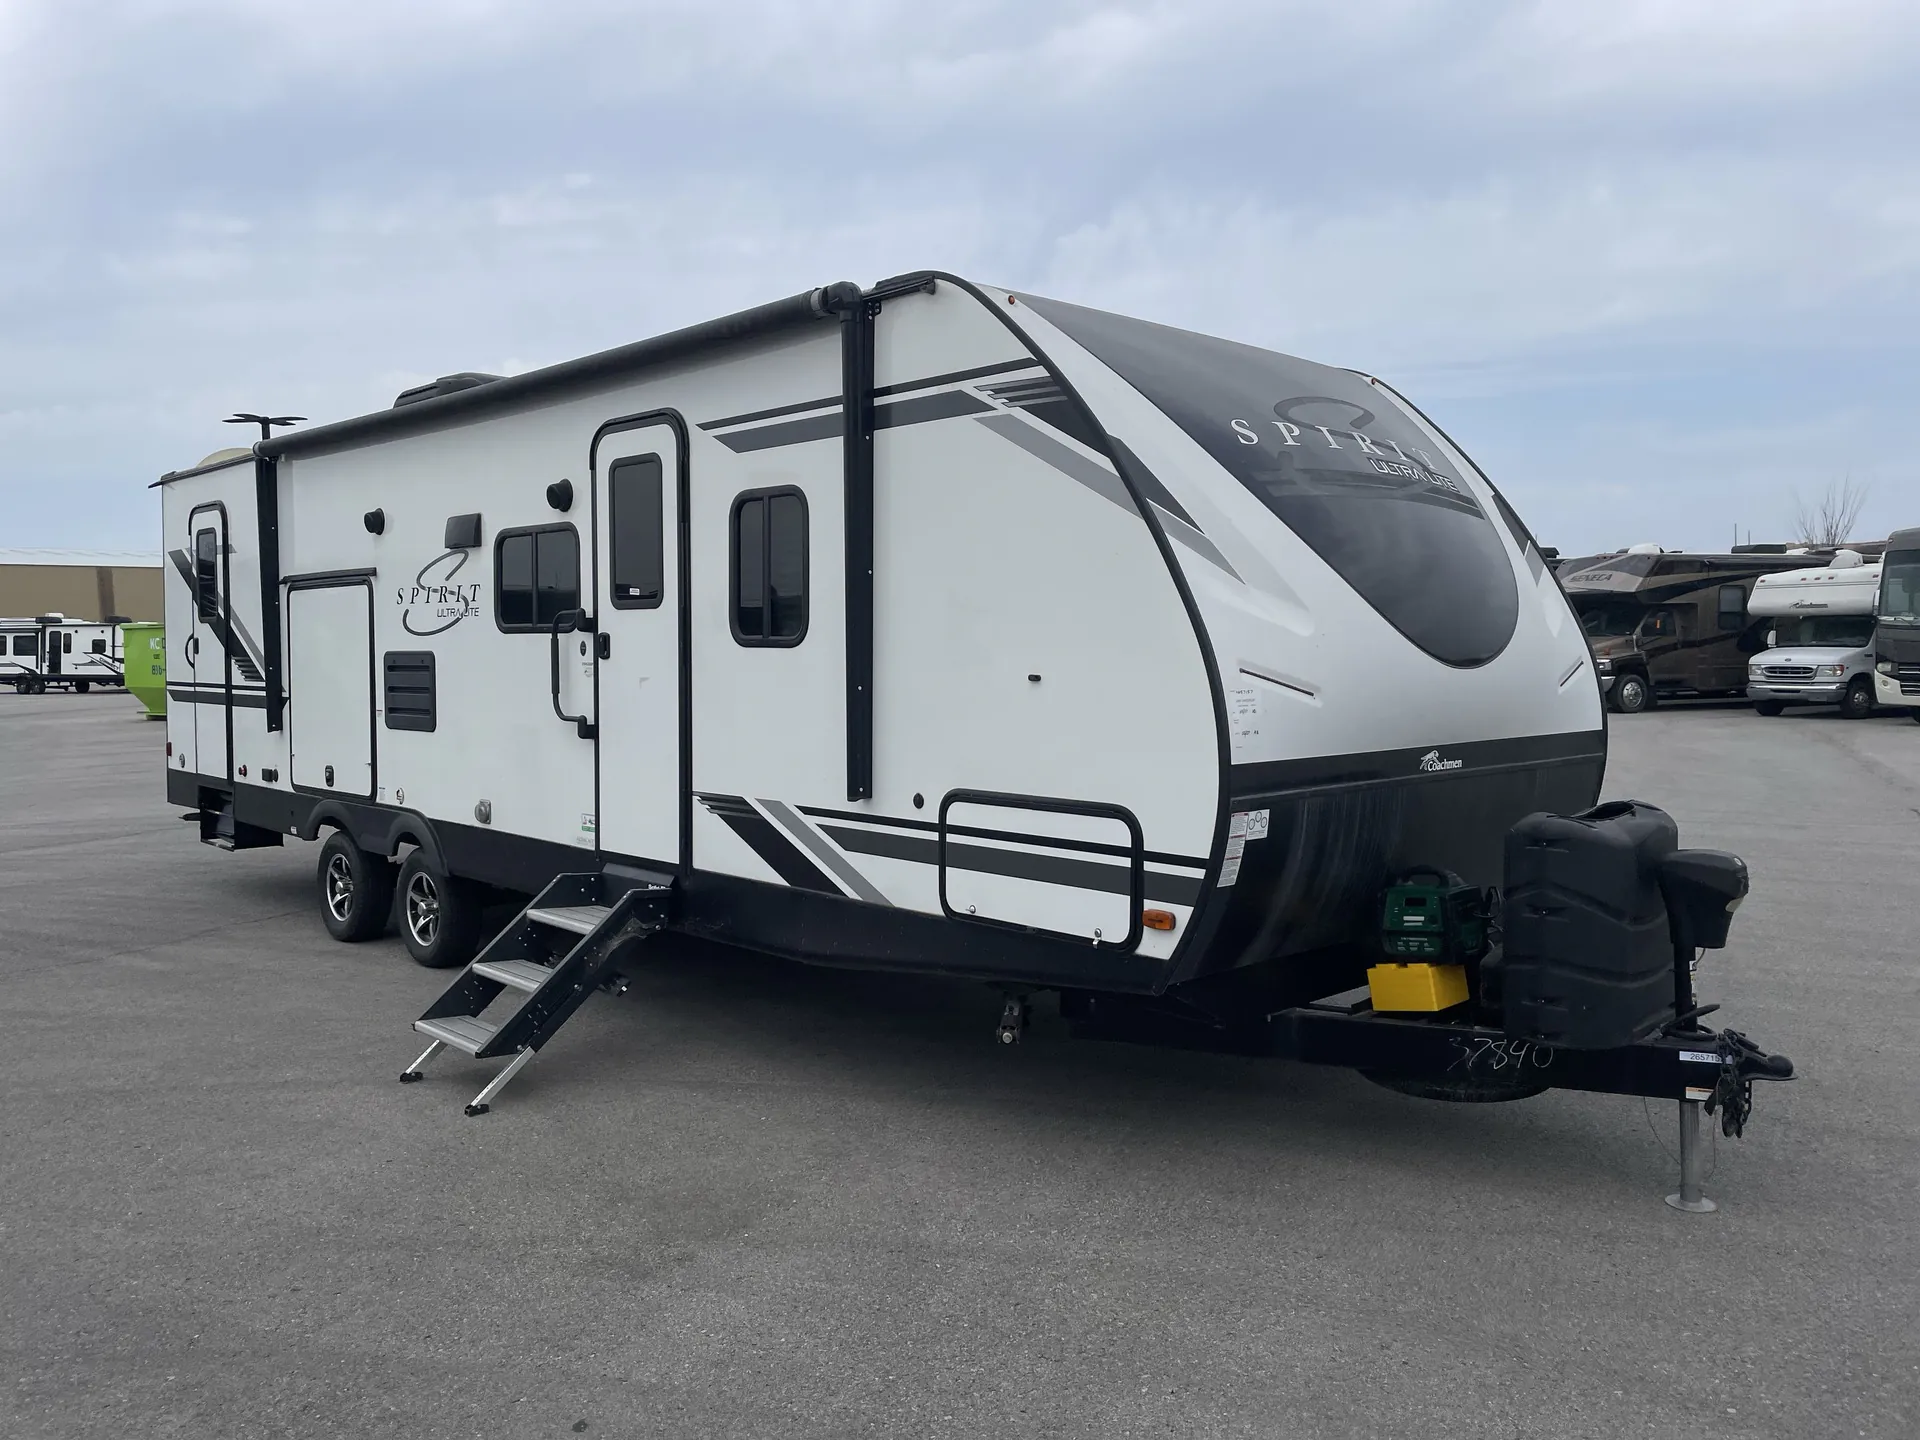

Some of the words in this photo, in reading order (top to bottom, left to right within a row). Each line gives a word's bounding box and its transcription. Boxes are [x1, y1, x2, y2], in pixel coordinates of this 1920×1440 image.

[1229, 418, 1438, 471] SPIRIT
[1367, 457, 1427, 482] ULTRA
[1424, 471, 1458, 491] LITE
[396, 583, 481, 605] SPIRIT
[437, 608, 461, 618] ULTRA
[1427, 758, 1463, 771] Coachmen
[1447, 1037, 1554, 1071] 37840
